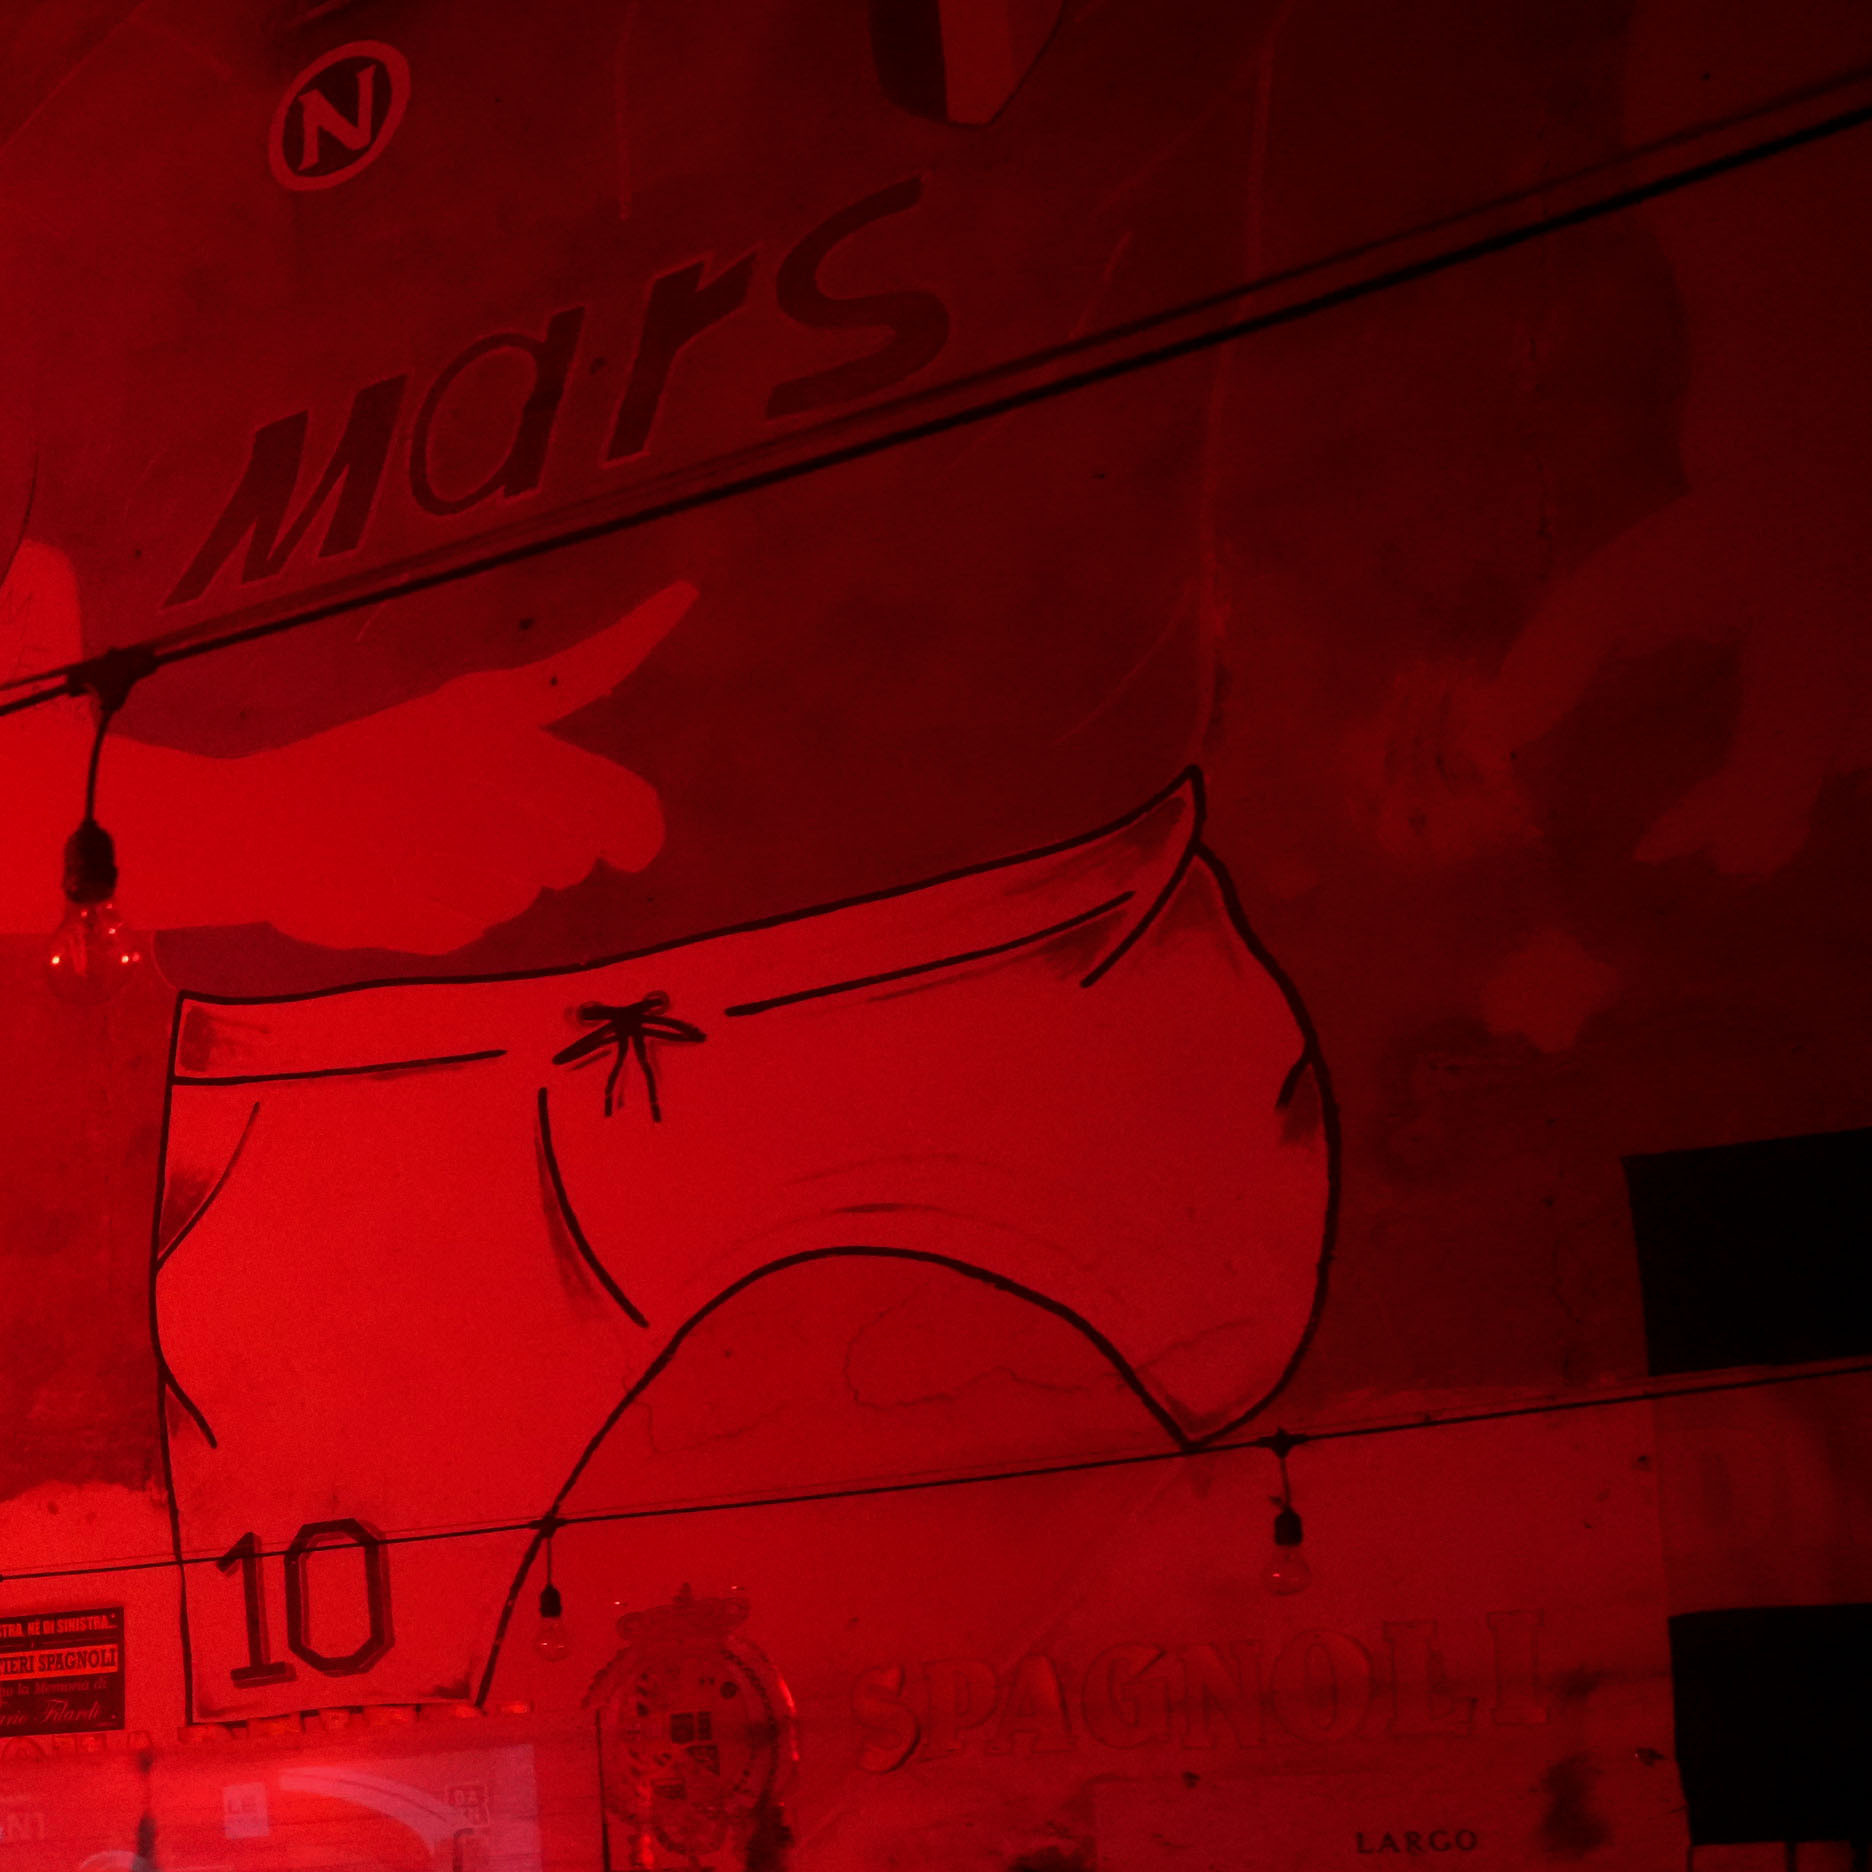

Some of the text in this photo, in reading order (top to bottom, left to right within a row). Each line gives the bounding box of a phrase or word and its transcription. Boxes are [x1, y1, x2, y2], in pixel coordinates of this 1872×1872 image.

[215, 1518, 396, 1690] 10
[37, 1646, 117, 1674] SPAGNOLI
[851, 1608, 1552, 1774] SPAGNOLI
[1354, 1828, 1480, 1856] LARGO
